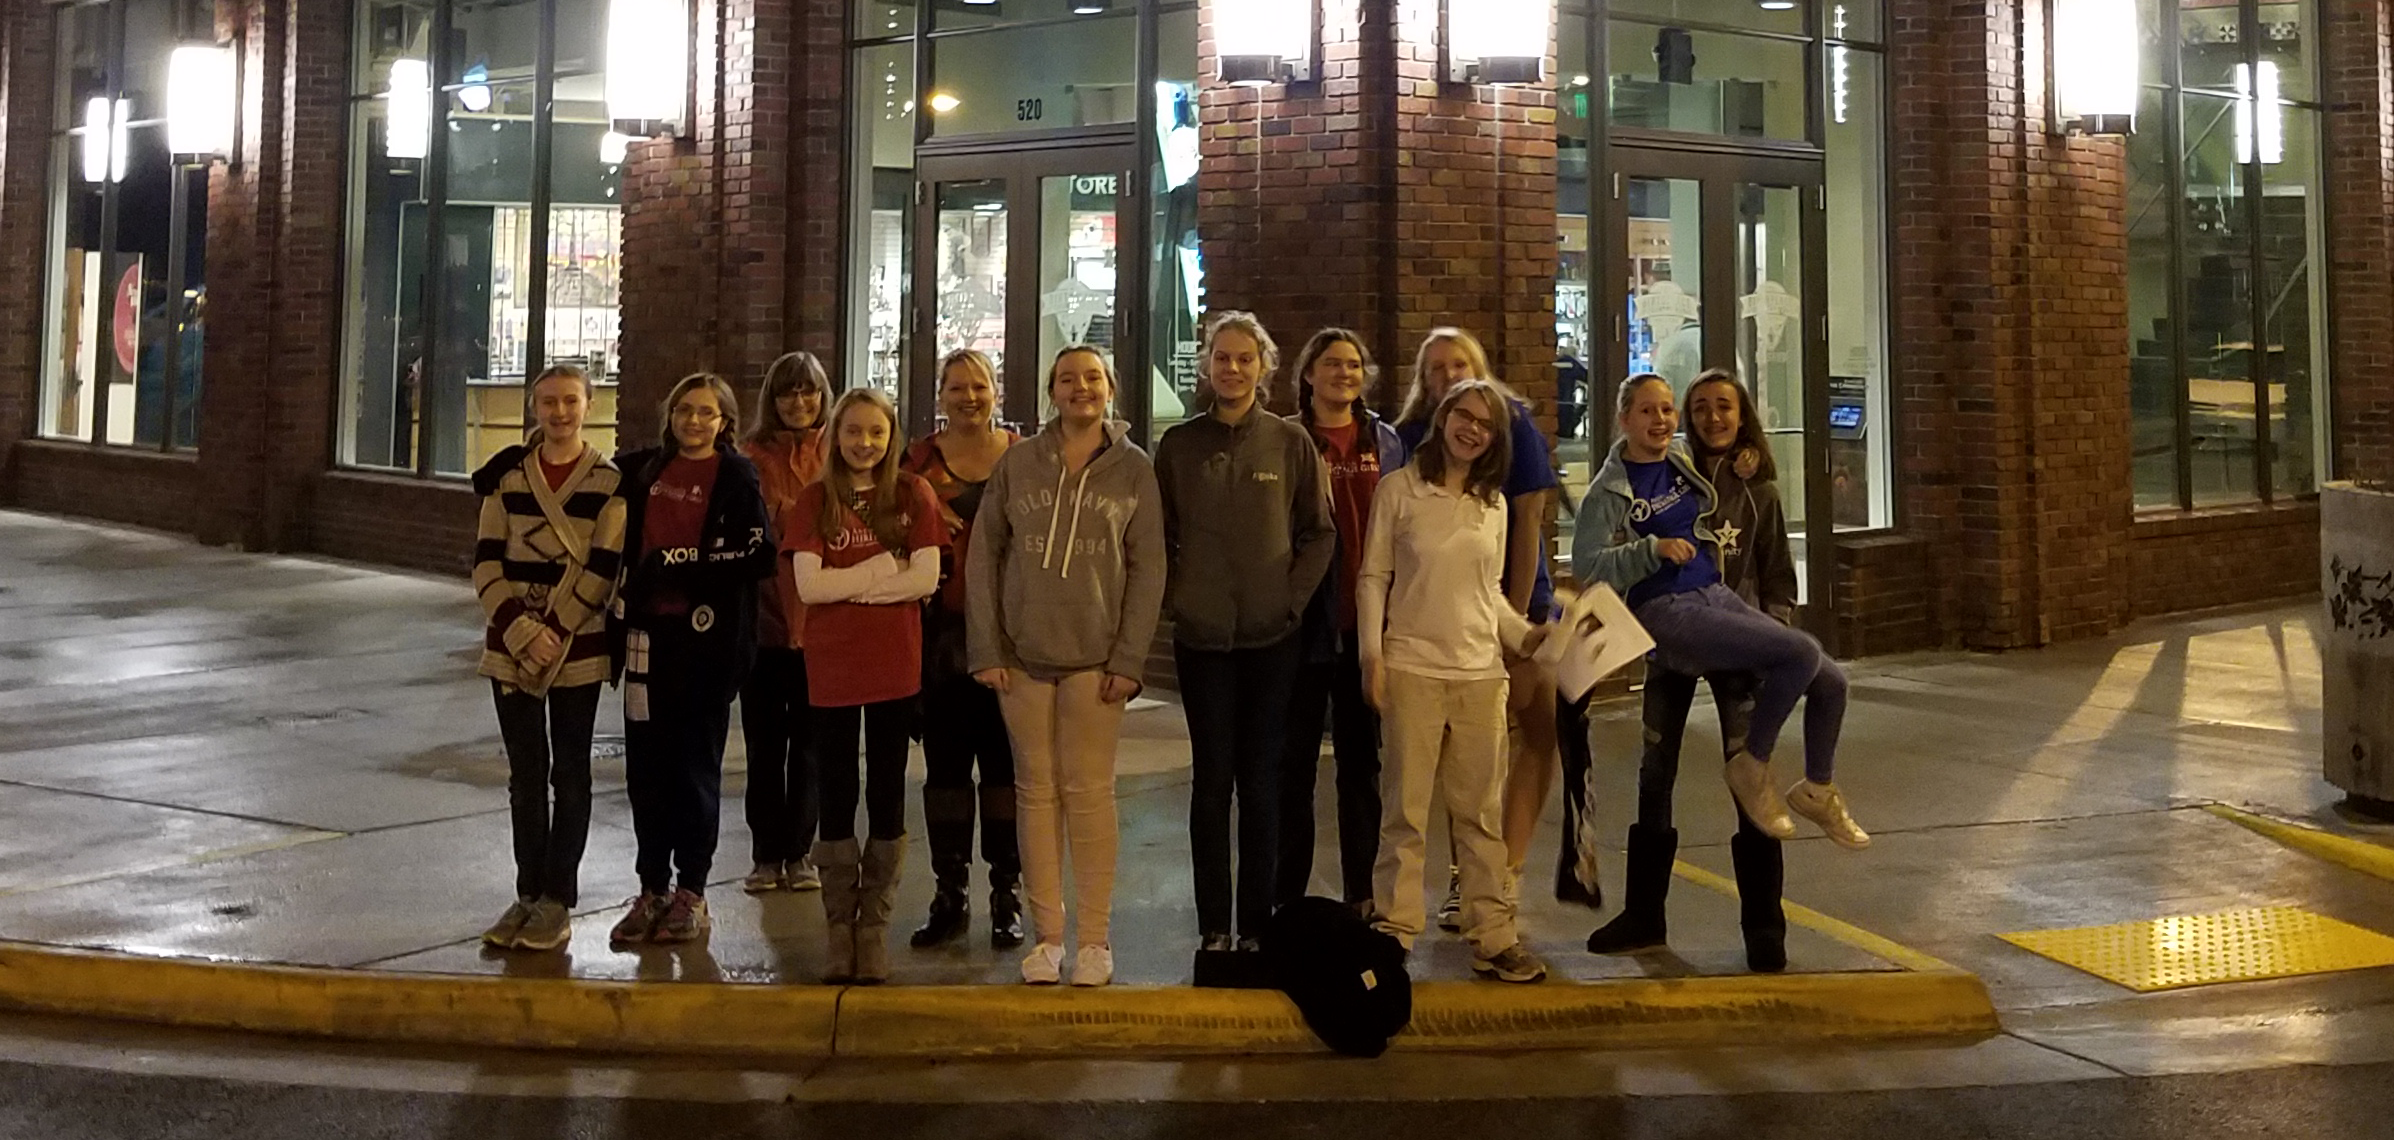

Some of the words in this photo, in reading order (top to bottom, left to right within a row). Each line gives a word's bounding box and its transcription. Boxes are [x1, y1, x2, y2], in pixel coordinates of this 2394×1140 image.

[1017, 98, 1042, 121] 520
[1018, 489, 1052, 516] OLD
[661, 547, 699, 566] BOX
[1068, 538, 1107, 555] 994
